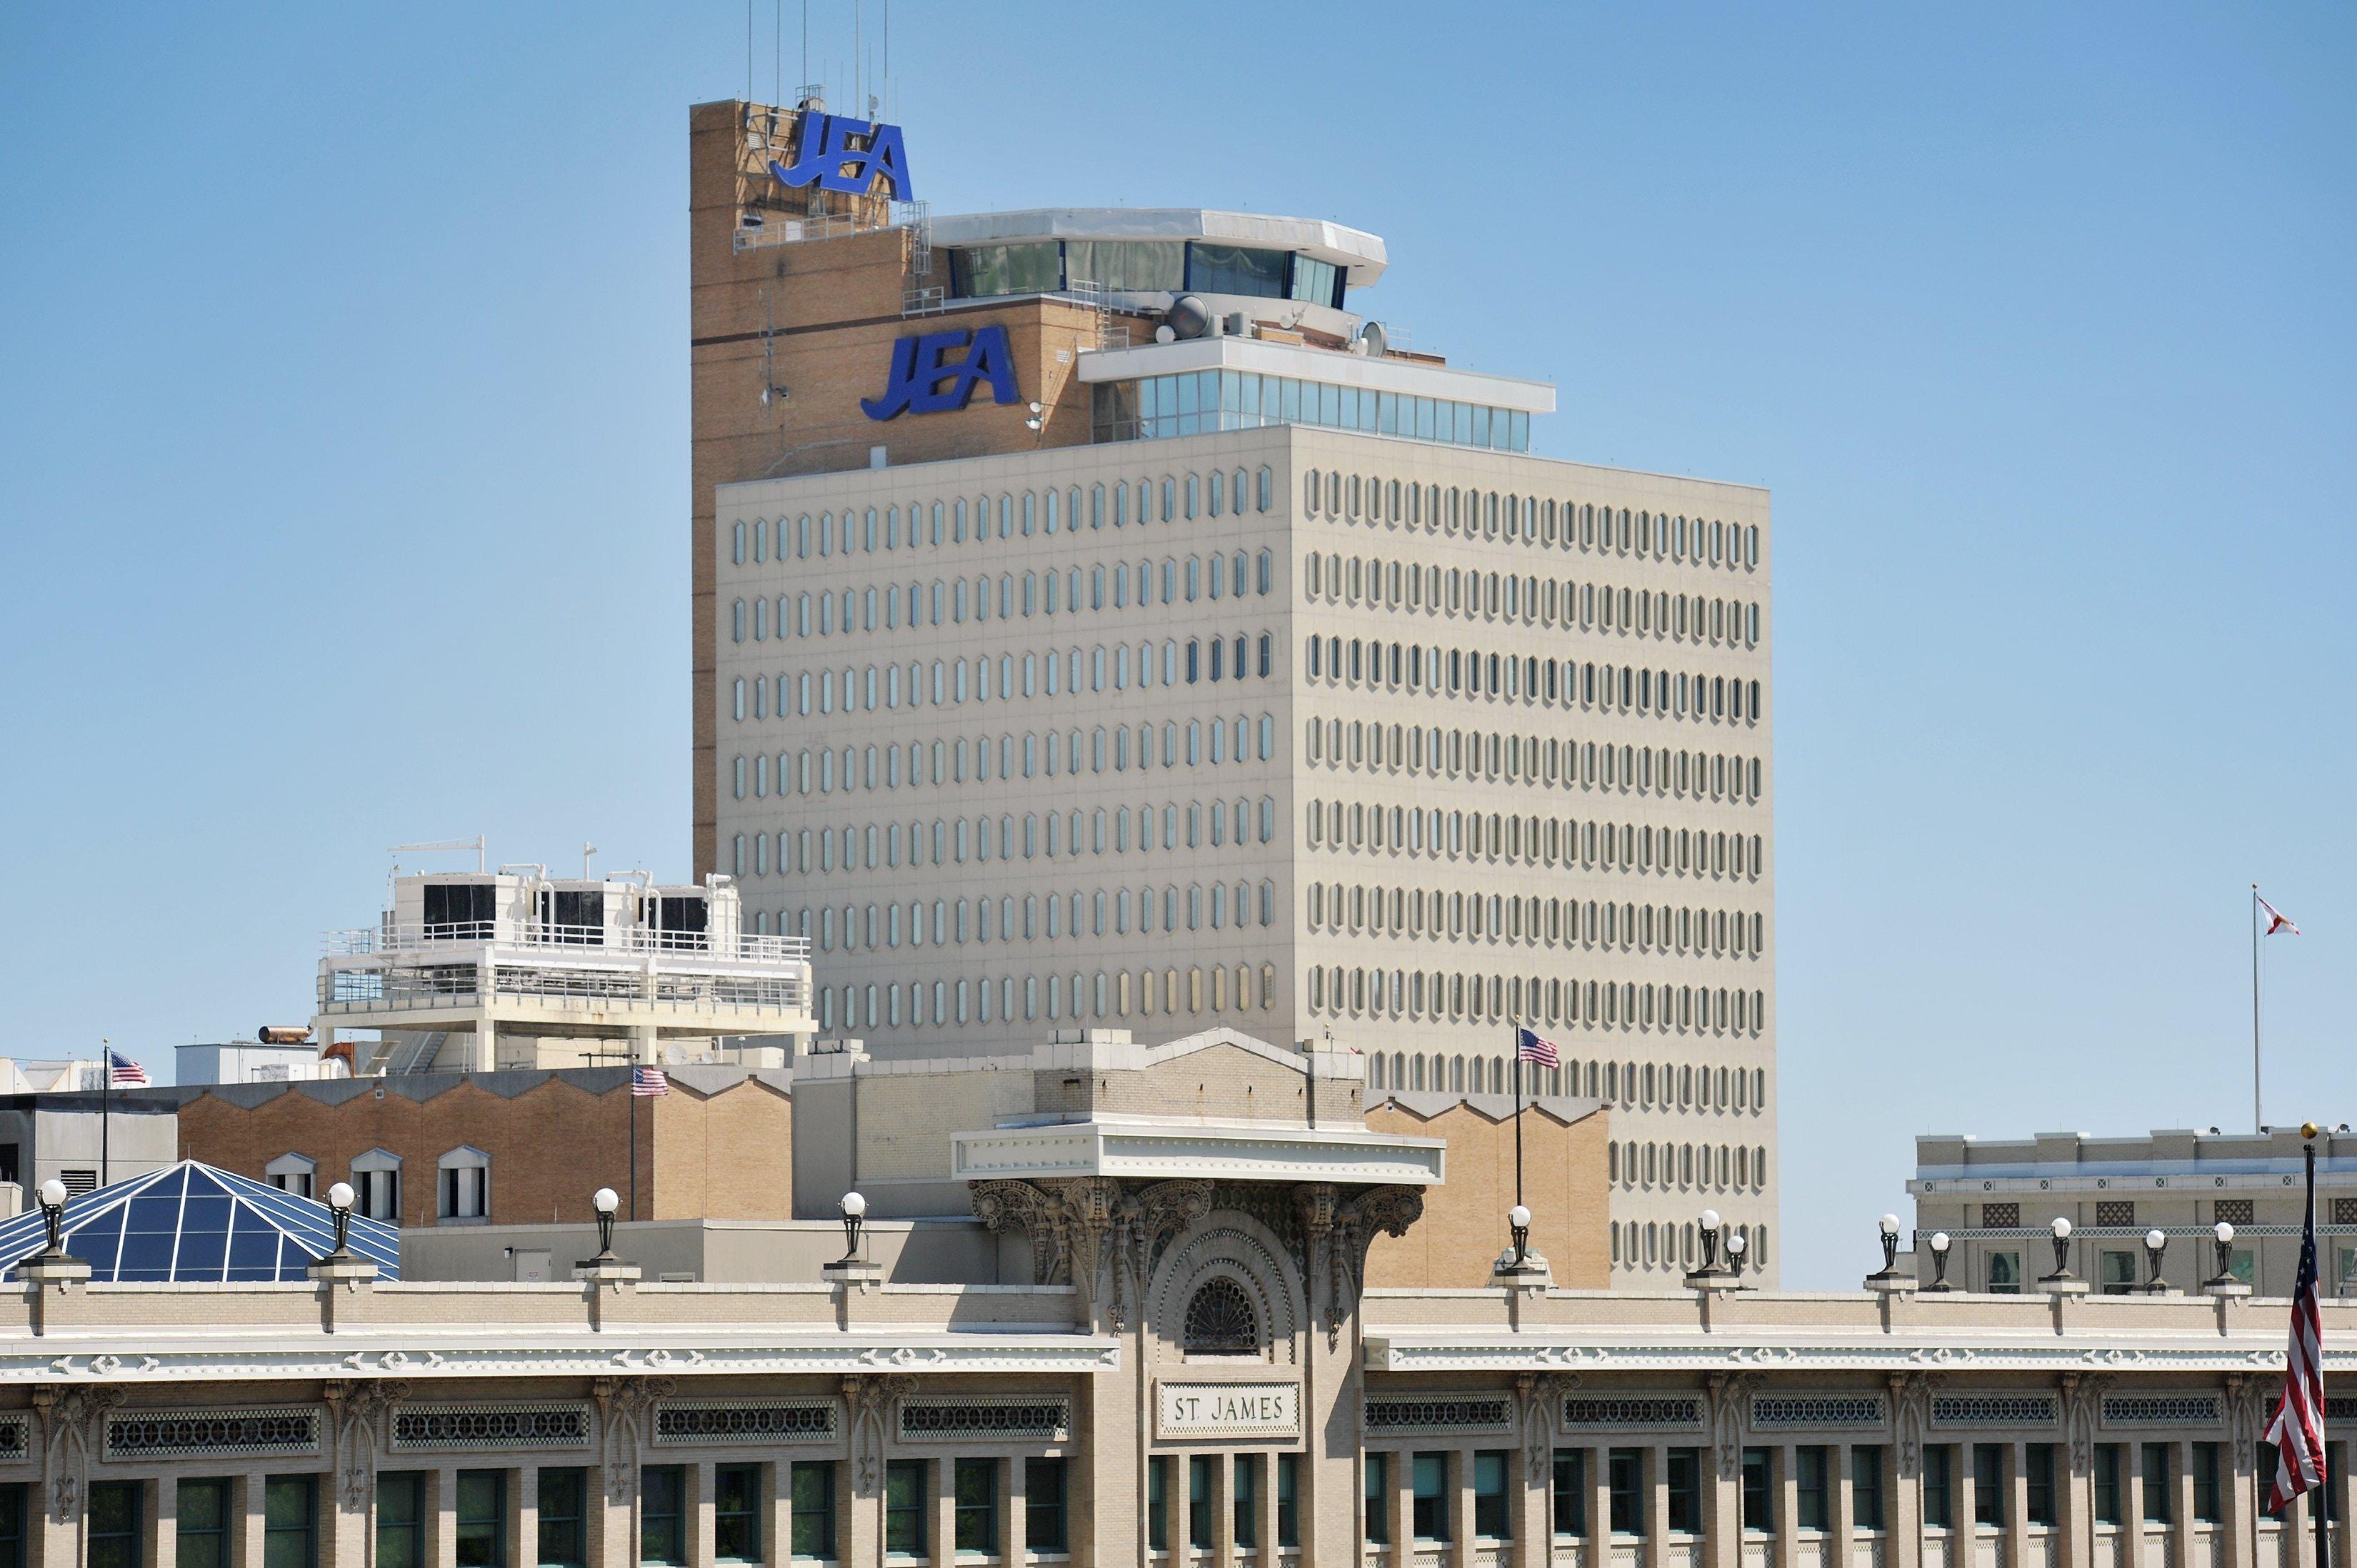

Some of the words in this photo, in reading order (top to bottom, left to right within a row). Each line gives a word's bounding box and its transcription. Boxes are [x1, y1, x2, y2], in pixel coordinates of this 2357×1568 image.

[770, 111, 913, 202] JEA
[861, 325, 1021, 421] JEA
[1211, 1396, 1283, 1420] JAMES
